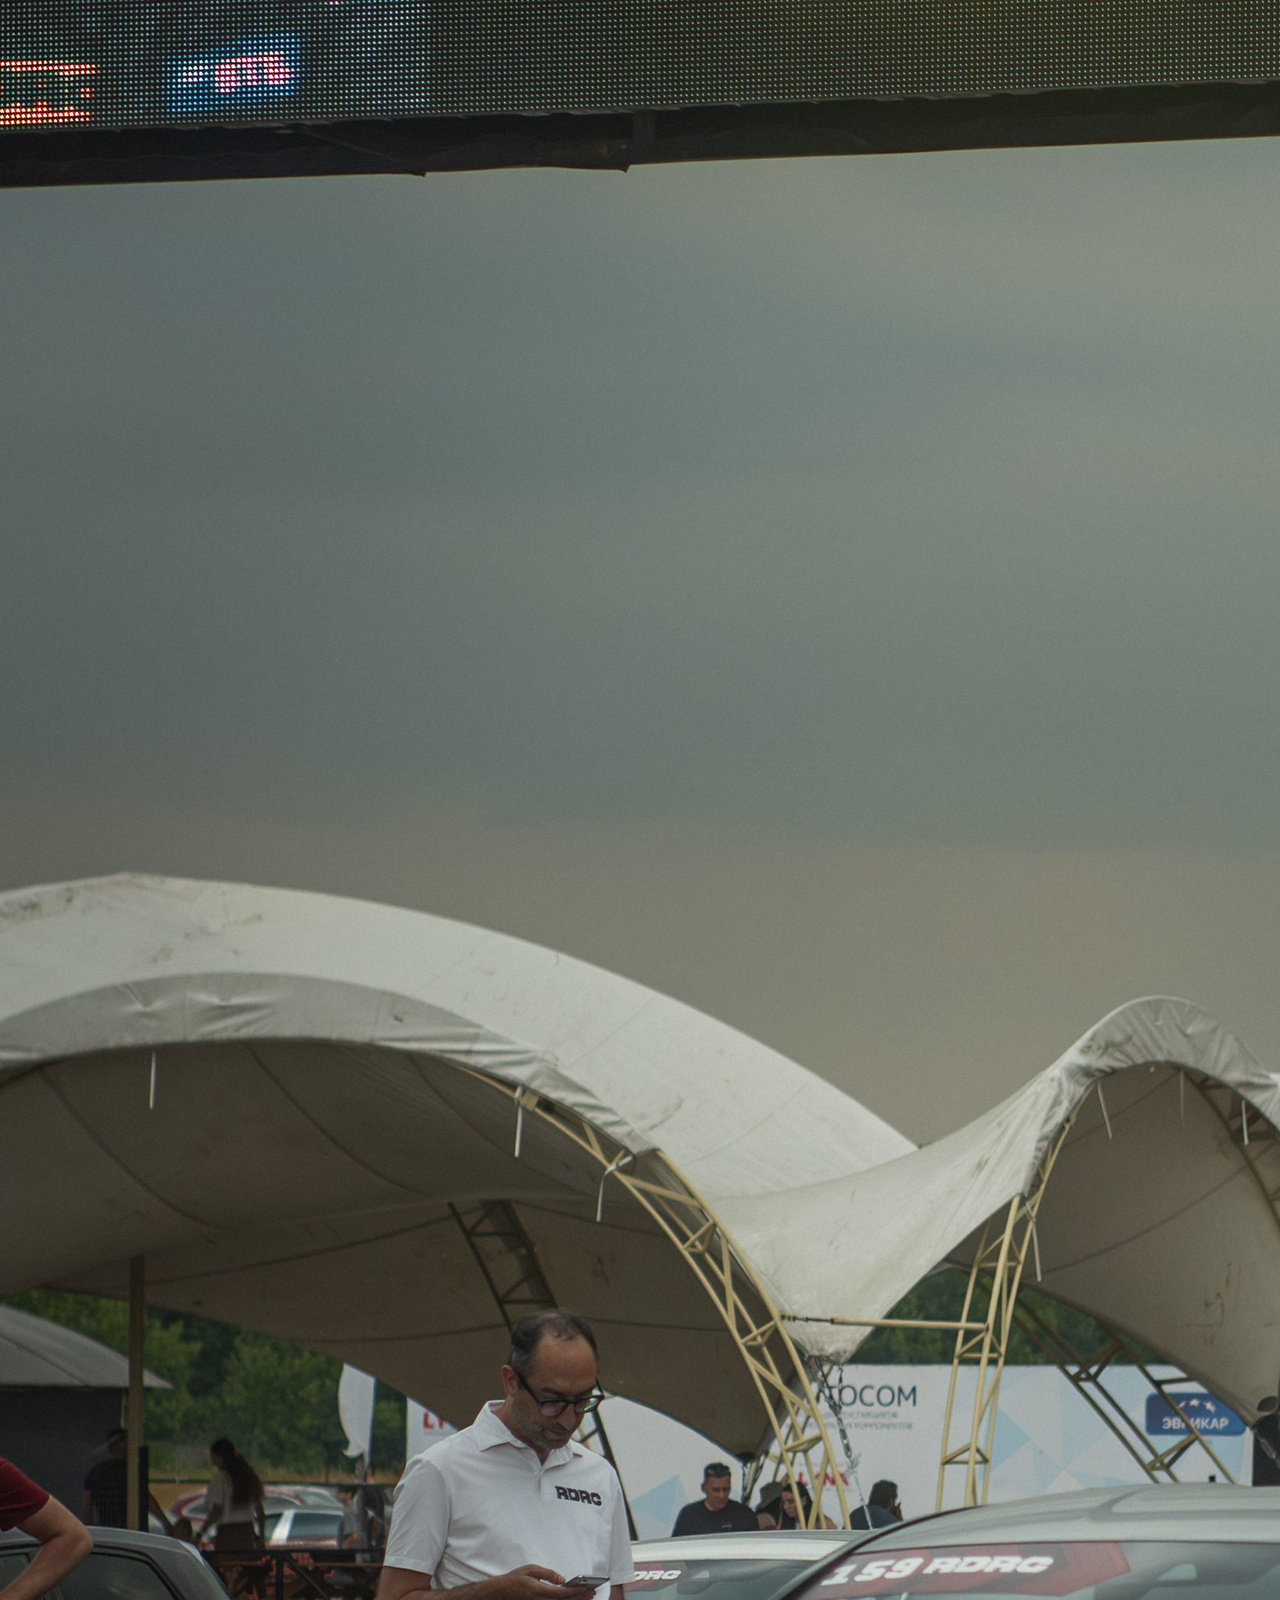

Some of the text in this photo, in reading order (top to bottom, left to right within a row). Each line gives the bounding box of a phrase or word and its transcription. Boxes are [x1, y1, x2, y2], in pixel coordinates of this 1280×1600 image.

[555, 1486, 602, 1506] RDRC
[634, 1569, 682, 1581] DRC
[820, 1556, 1054, 1586] 159 RDRC
